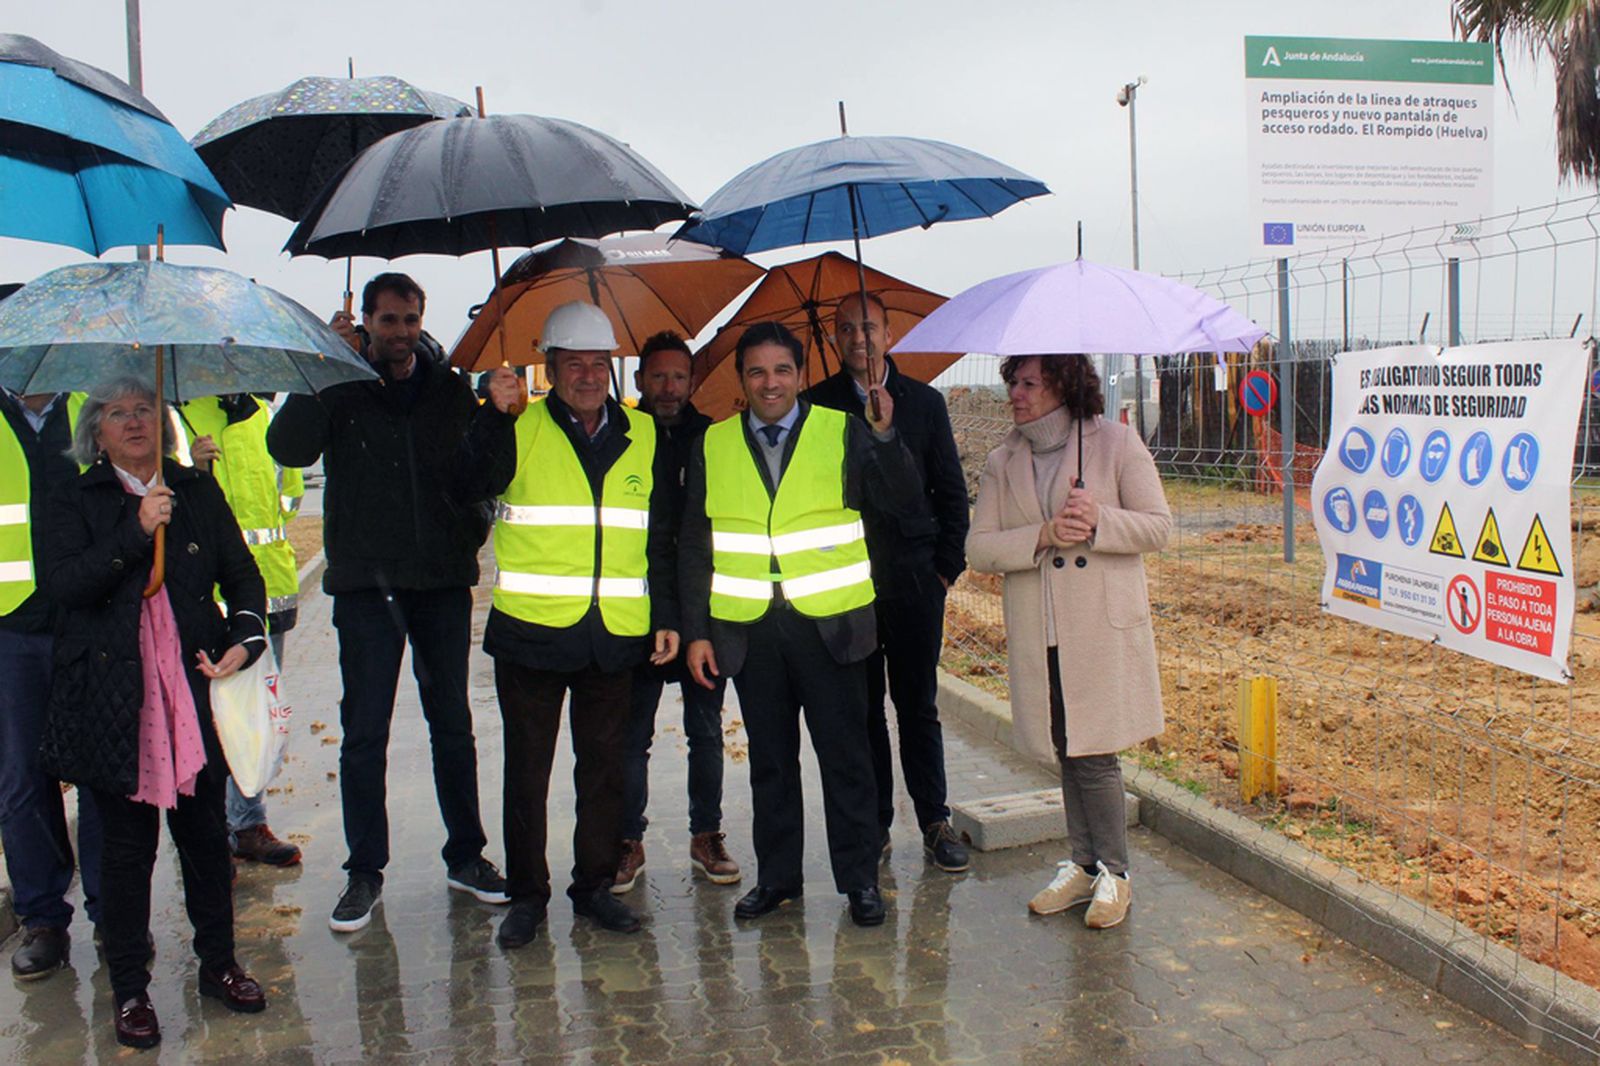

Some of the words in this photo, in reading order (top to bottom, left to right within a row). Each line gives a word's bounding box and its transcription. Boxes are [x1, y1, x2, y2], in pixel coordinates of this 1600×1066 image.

[1284, 51, 1308, 61] Junta
[1310, 51, 1321, 61] de
[1321, 51, 1364, 62] Andalucía
[1261, 90, 1334, 106] Ampliación
[1337, 92, 1353, 105] de
[1356, 93, 1368, 105] la
[1404, 94, 1420, 107] de
[1422, 96, 1478, 110] atraques
[1262, 108, 1329, 121] pesqueros
[1331, 109, 1340, 122] y
[1343, 110, 1382, 121] nuevo
[1384, 109, 1440, 123] pantalán
[1442, 111, 1458, 123] de
[1262, 123, 1305, 134] acceso
[1308, 122, 1358, 135] rodado.
[1362, 123, 1374, 135] El
[1377, 124, 1434, 139] Rompido
[1436, 125, 1488, 140] (Huelva)
[1297, 222, 1326, 233] UNIÓN
[1327, 224, 1366, 233] EUROPEA
[1360, 369, 1371, 389] ES
[1442, 364, 1491, 387] SEGUIR
[1494, 363, 1543, 387] TODAS
[1358, 394, 1380, 415] AS
[1382, 394, 1431, 416] NORMAS
[1433, 395, 1450, 416] DE
[1451, 394, 1527, 418] SEGURIDAD
[1496, 578, 1542, 598] PROHIBIDO
[1487, 592, 1497, 605] EL
[1498, 594, 1520, 610] PASO
[1520, 599, 1527, 612] A
[1528, 600, 1552, 617] TODA
[1487, 608, 1523, 628] PERSONA
[1524, 617, 1552, 635] AJENA
[1497, 627, 1503, 639] A
[1504, 628, 1515, 642] LA
[1515, 631, 1538, 648] OBRA
